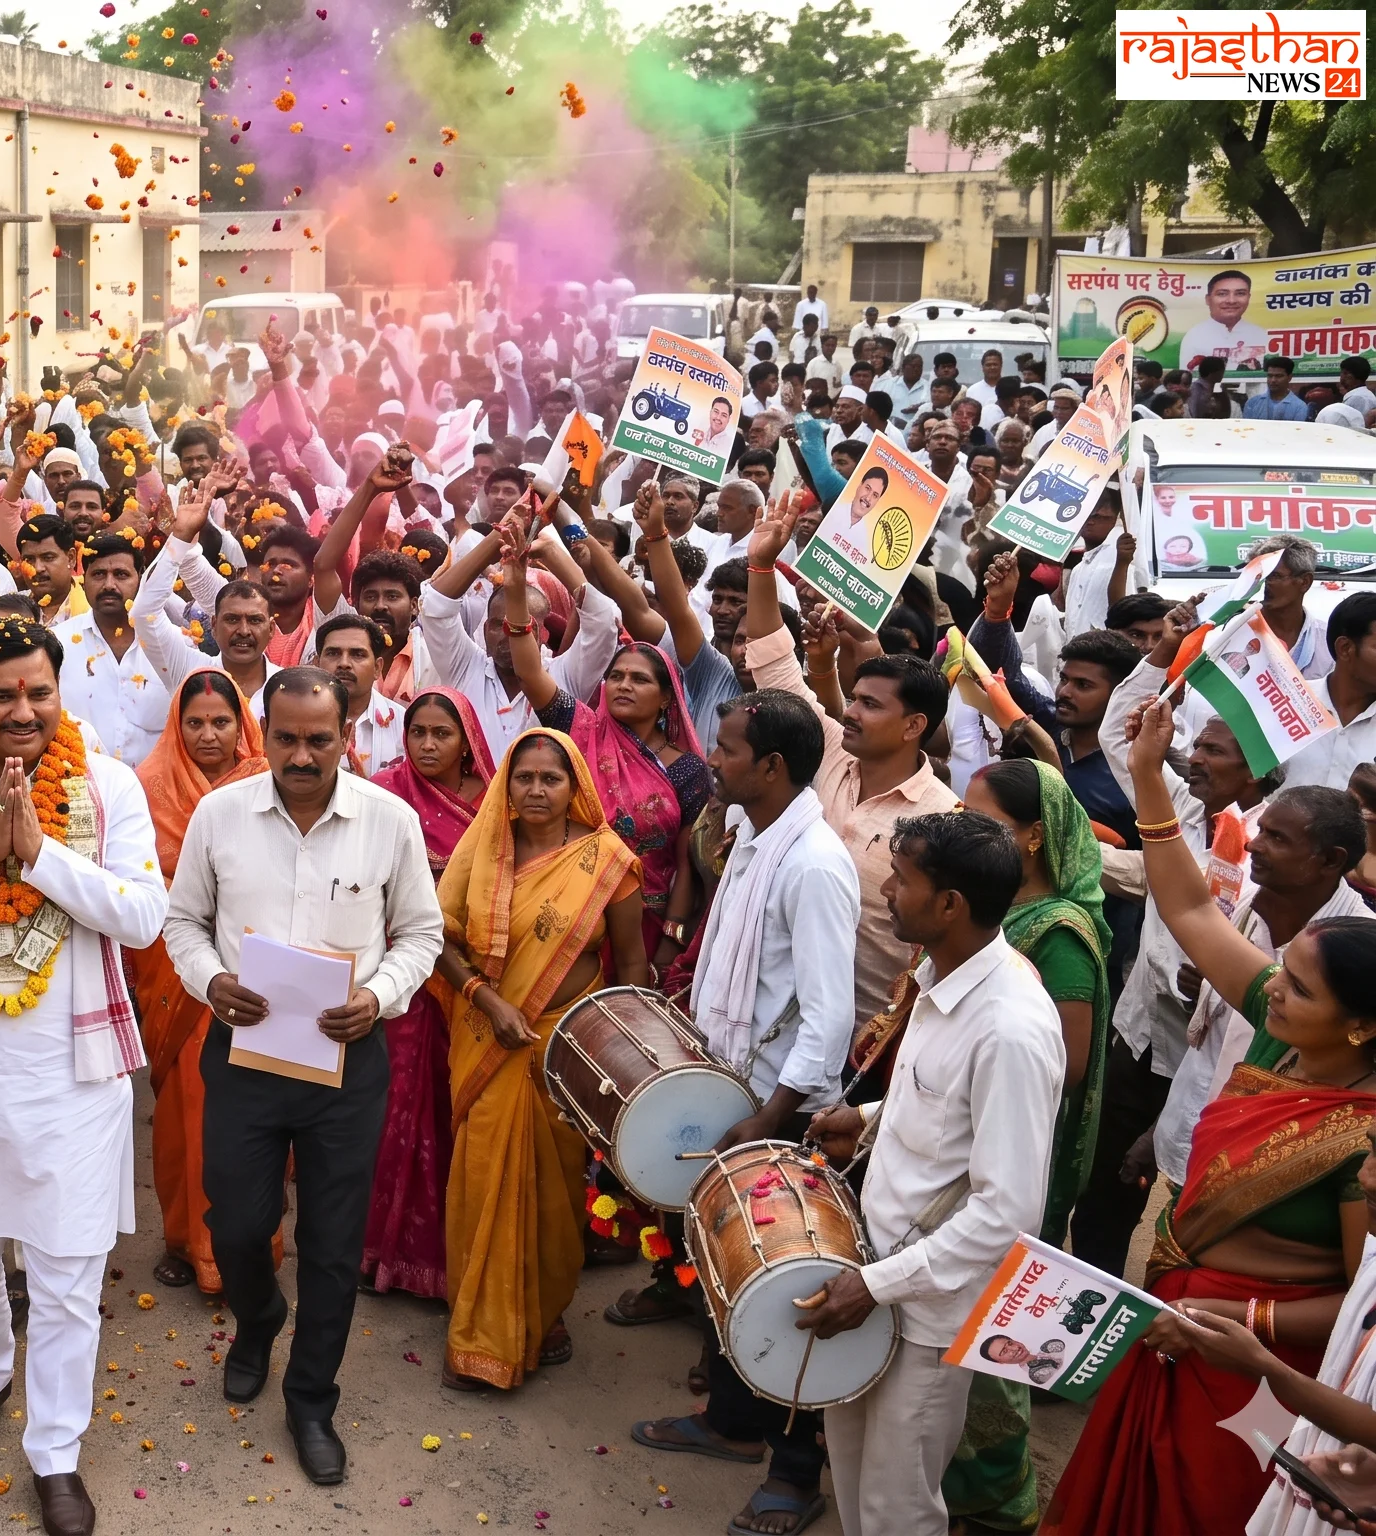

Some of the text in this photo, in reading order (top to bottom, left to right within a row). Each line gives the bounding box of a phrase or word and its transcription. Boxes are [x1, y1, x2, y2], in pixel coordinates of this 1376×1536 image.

[1124, 274, 1152, 291] पद
[1340, 282, 1372, 305] की
[1268, 318, 1376, 357] नामांक
